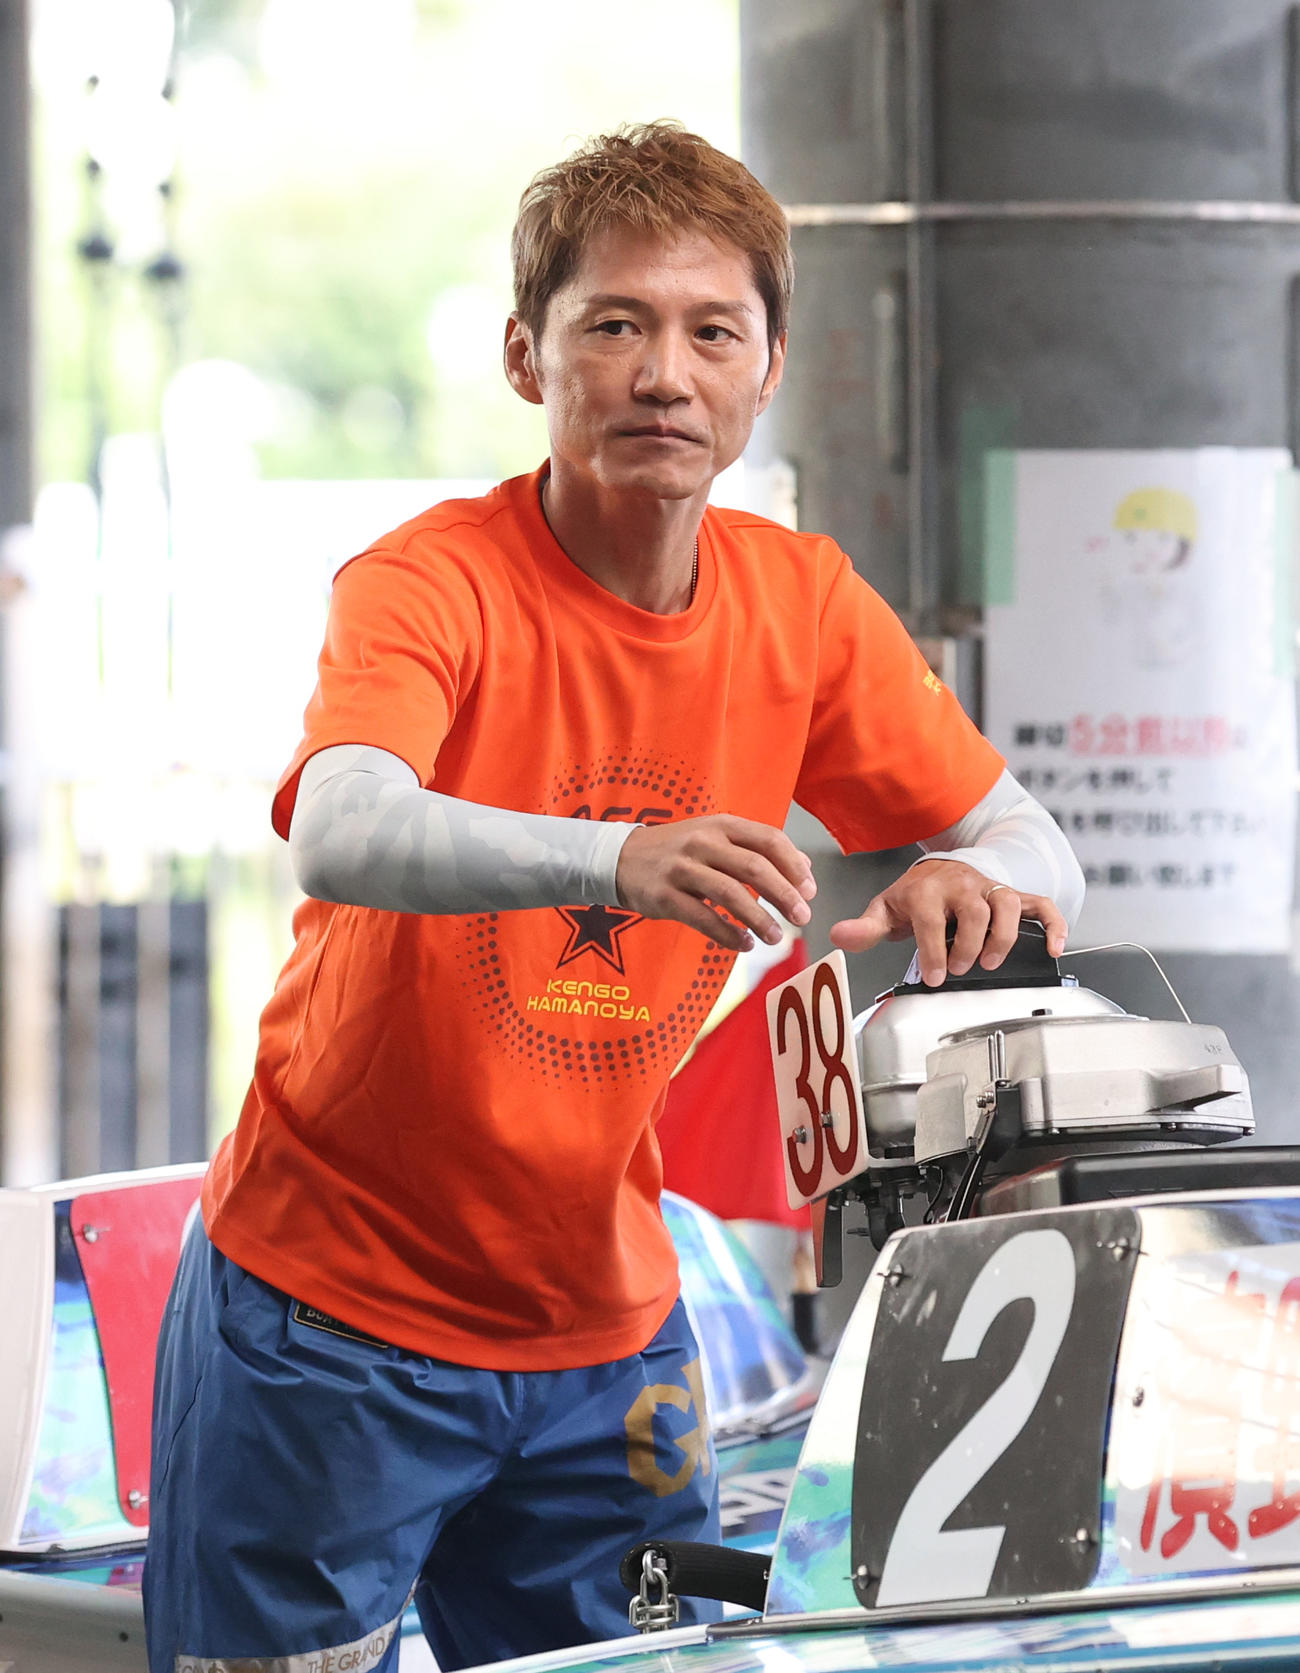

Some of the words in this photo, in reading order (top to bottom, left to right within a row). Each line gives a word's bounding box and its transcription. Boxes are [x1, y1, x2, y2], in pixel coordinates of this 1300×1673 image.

[527, 996, 650, 1022] HAMANOYA
[547, 979, 630, 1000] KENGO
[776, 962, 859, 1198] 38
[875, 1228, 1077, 1608] 2
